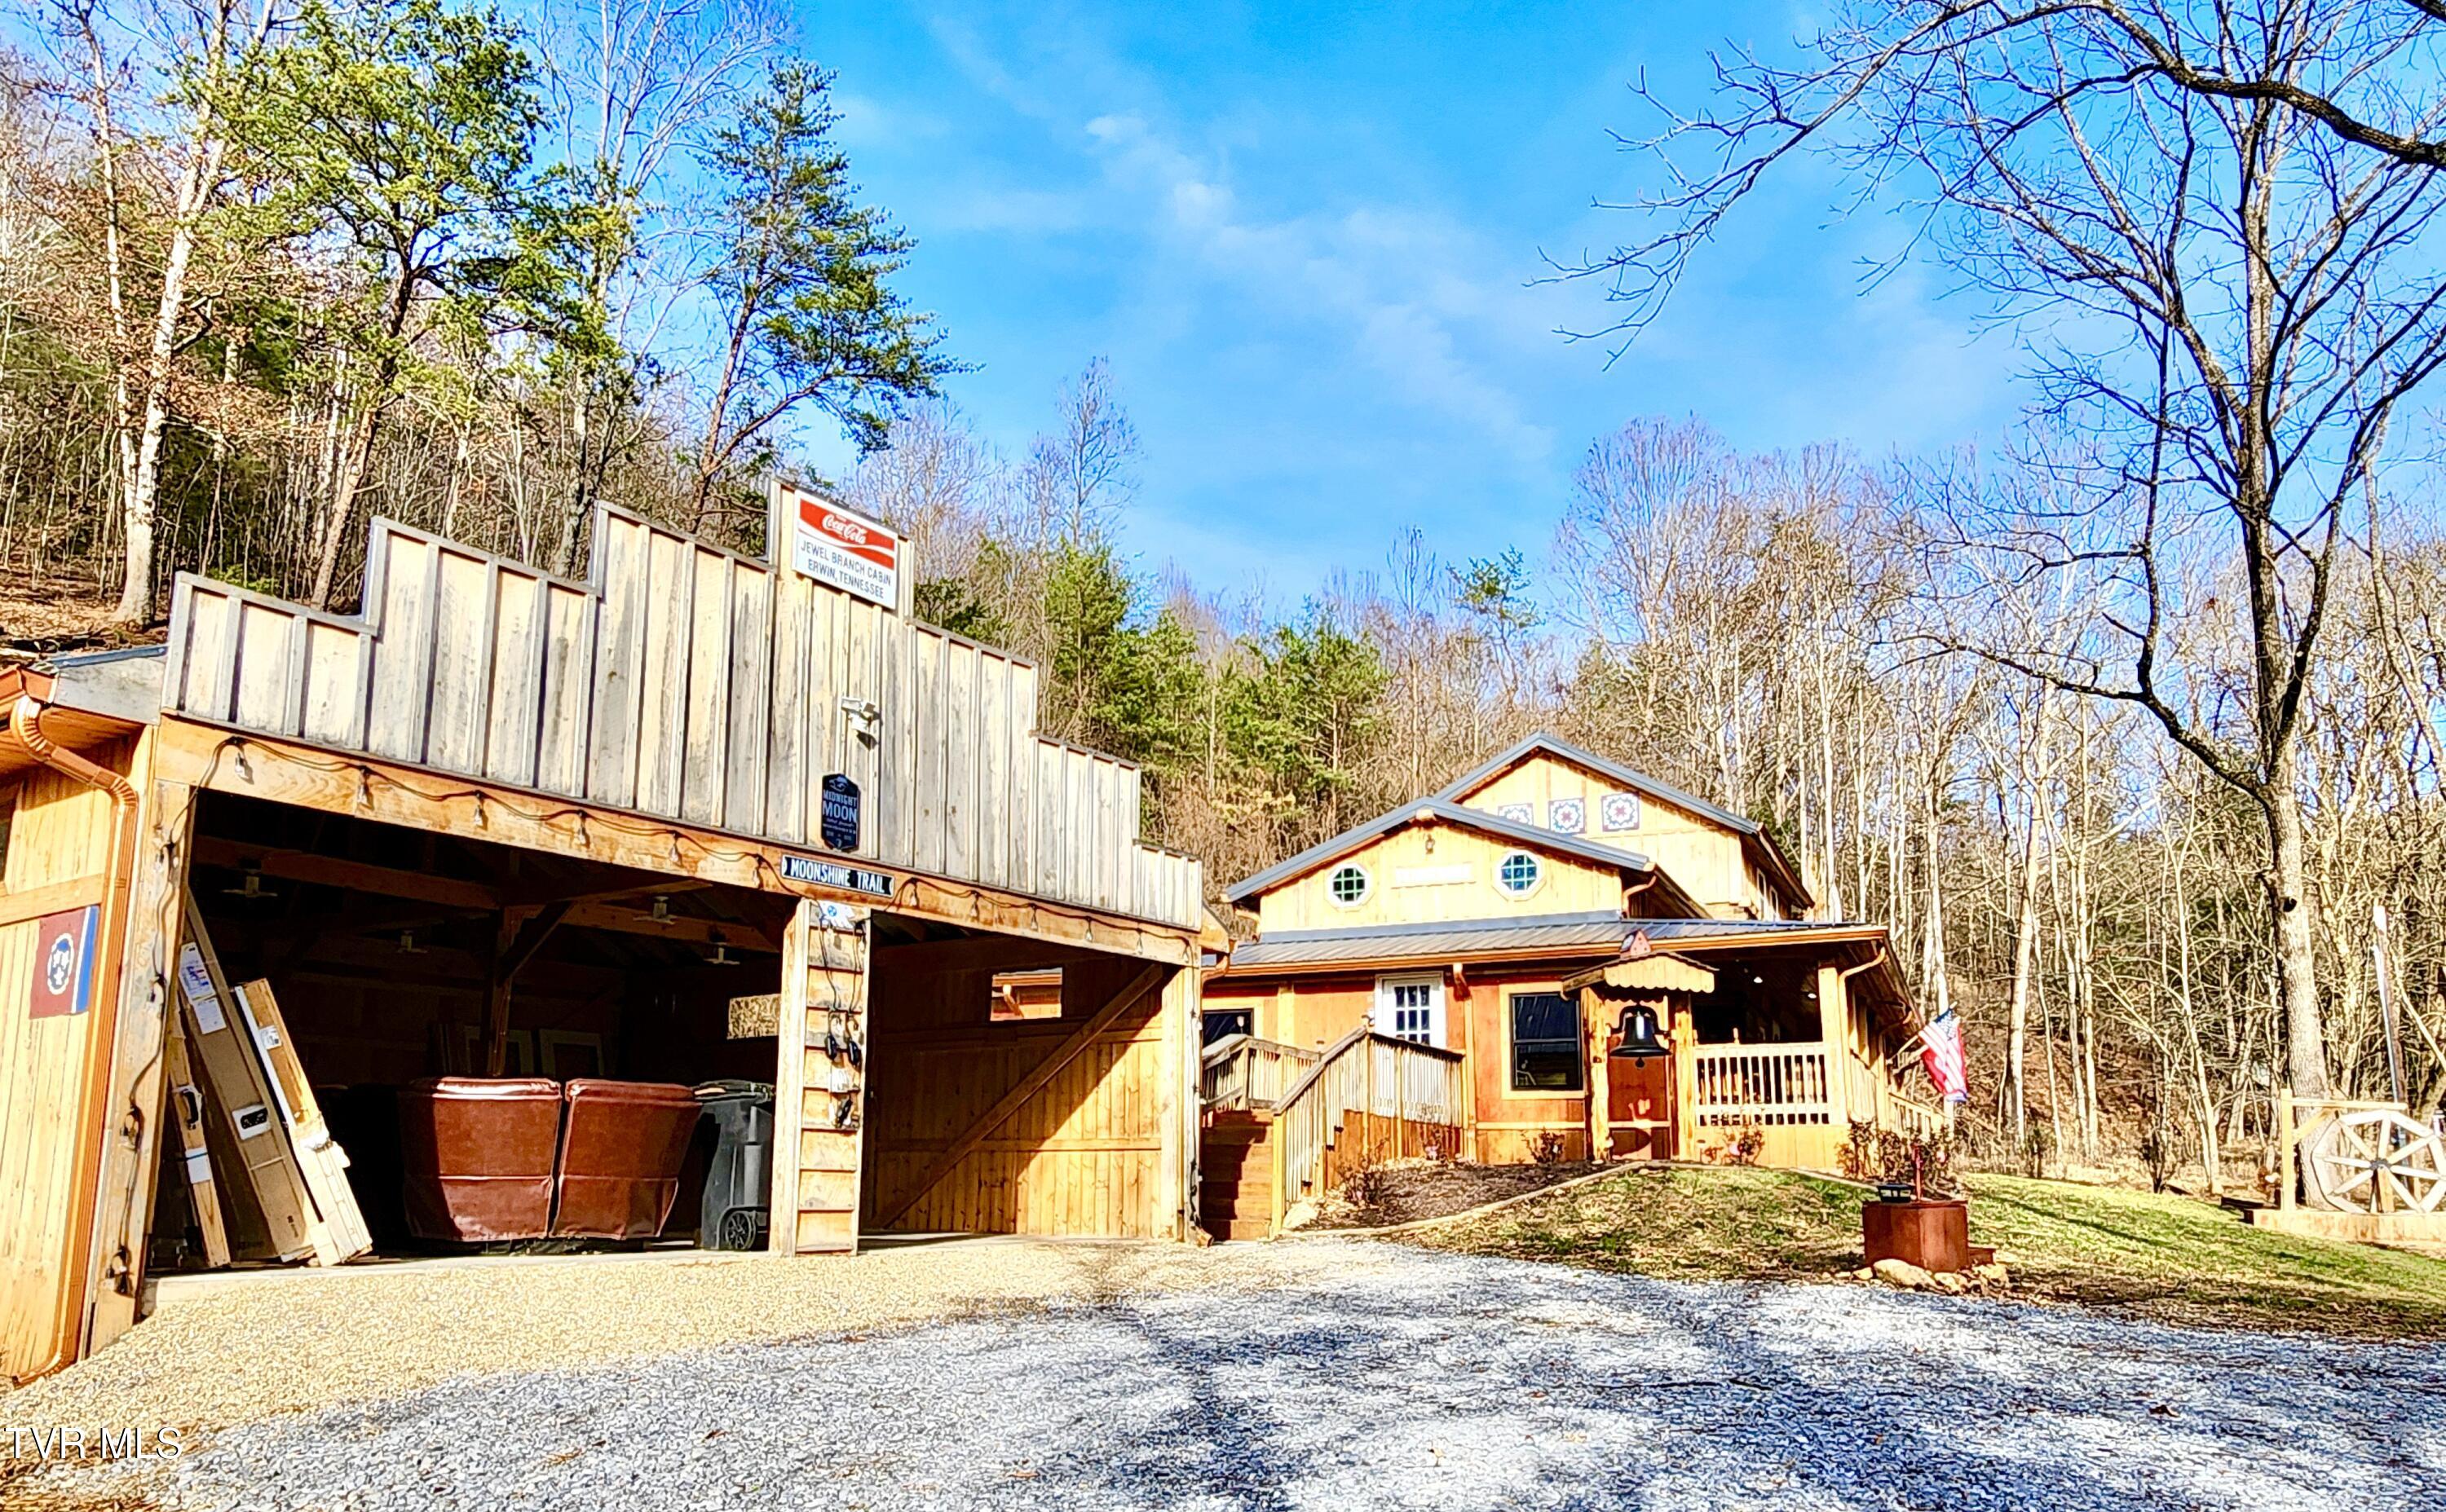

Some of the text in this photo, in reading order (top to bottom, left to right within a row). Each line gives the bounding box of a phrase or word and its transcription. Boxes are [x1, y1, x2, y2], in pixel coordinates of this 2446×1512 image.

[801, 540, 891, 586] JEWEL BRANCH CABIN
[808, 558, 884, 599] ERWIN, TENNESSEE
[822, 800, 857, 823] MOON
[823, 789, 857, 807] MIDNIGHT
[790, 858, 885, 893] MOONSHINE TRAIL
